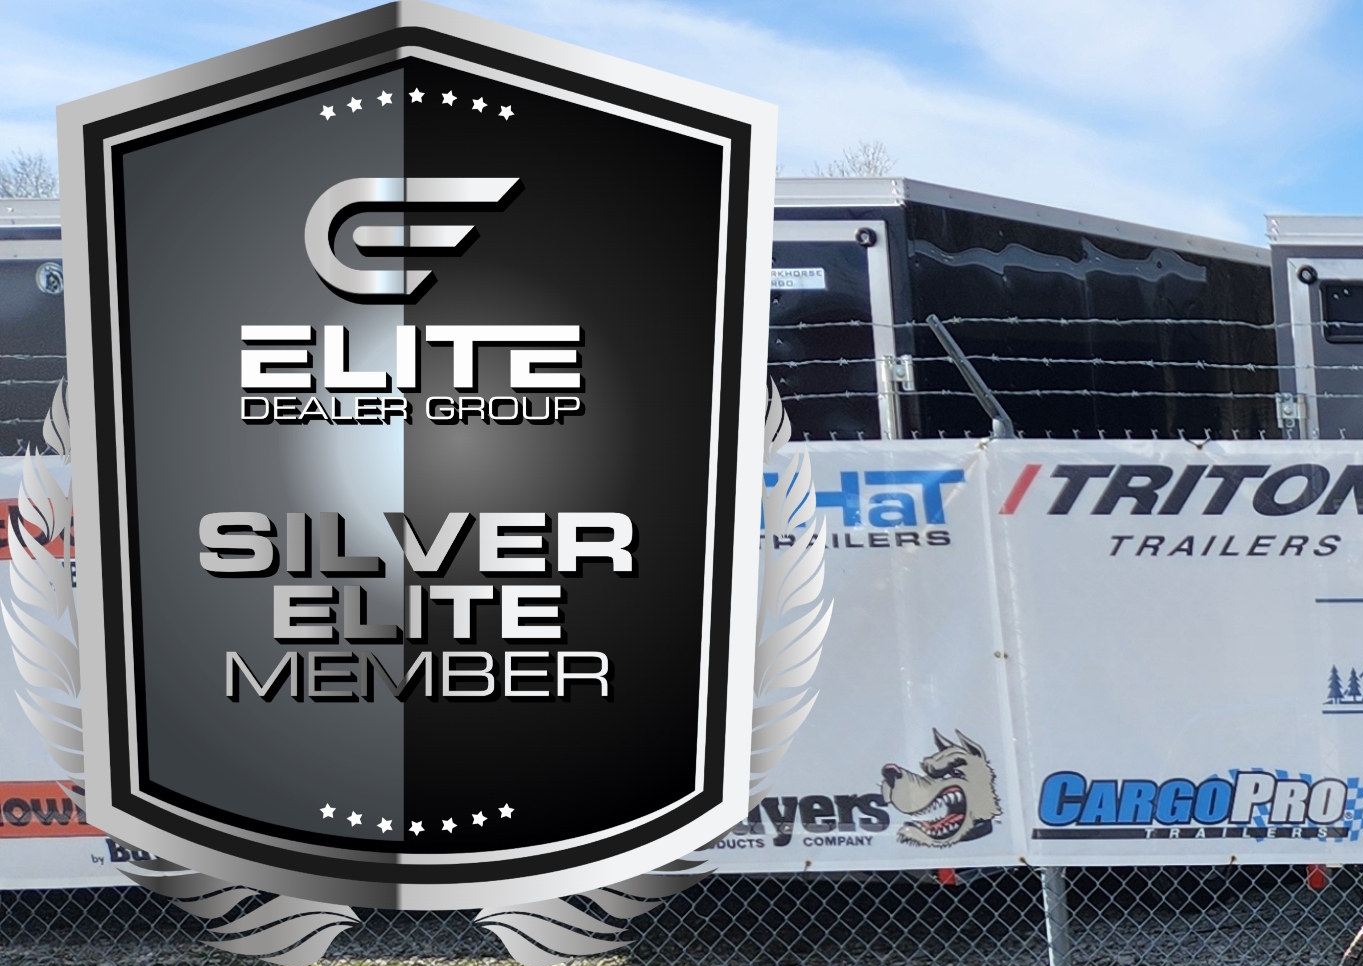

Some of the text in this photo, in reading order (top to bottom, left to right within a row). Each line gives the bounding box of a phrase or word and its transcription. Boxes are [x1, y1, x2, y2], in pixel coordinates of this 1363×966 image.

[1109, 535, 1342, 557] TRAILERS
[731, 793, 891, 847] uyers
[1144, 827, 1329, 839] TRAILERS
[802, 835, 874, 847] COMPANY
[91, 854, 104, 865] by
